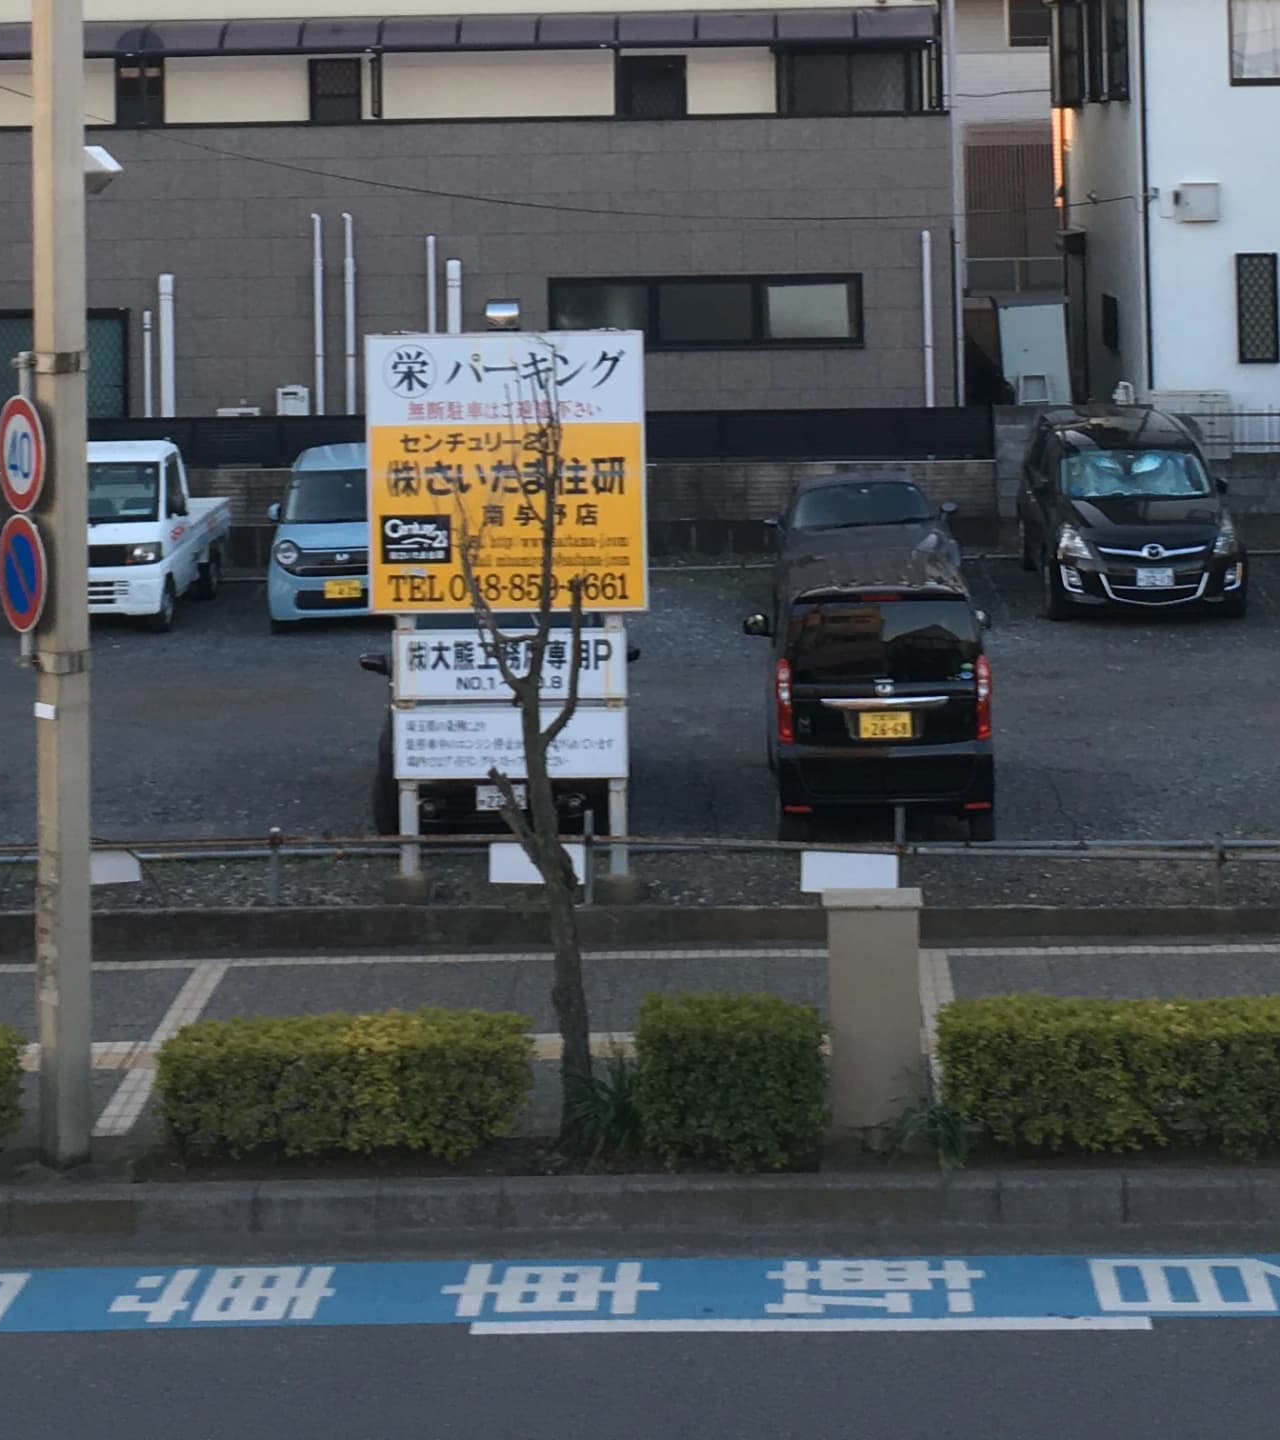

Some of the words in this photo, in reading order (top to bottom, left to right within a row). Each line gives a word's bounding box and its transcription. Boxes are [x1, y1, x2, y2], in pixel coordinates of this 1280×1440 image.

[445, 349, 626, 390] パーキング
[7, 430, 32, 480] 40
[388, 574, 444, 602] TEL
